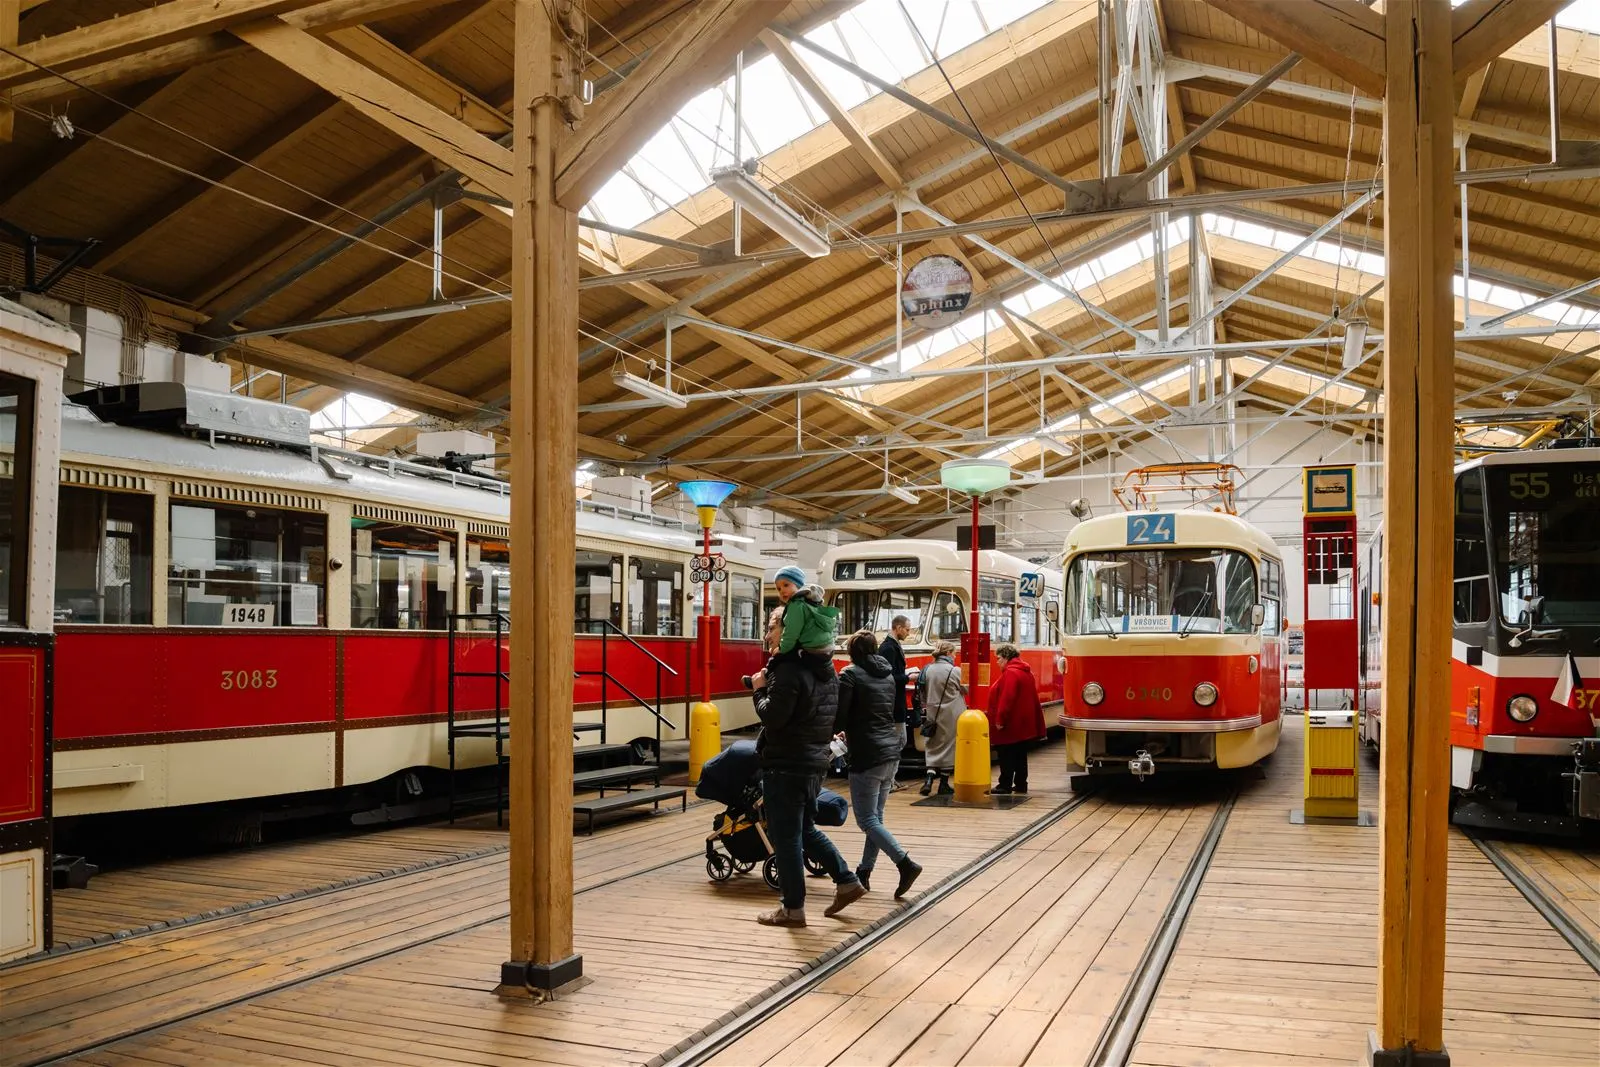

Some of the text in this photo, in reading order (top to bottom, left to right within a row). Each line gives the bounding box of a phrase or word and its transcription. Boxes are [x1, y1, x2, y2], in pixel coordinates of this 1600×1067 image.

[1509, 472, 1550, 499] 55
[1132, 516, 1171, 542] 24
[841, 565, 850, 579] 4
[867, 565, 896, 575] ZAHRADNÍ
[1020, 576, 1038, 595] 24
[231, 608, 266, 623] 1948
[1134, 617, 1168, 626] VRŠOVICE
[220, 669, 278, 690] 3083
[1126, 686, 1172, 701] 6340
